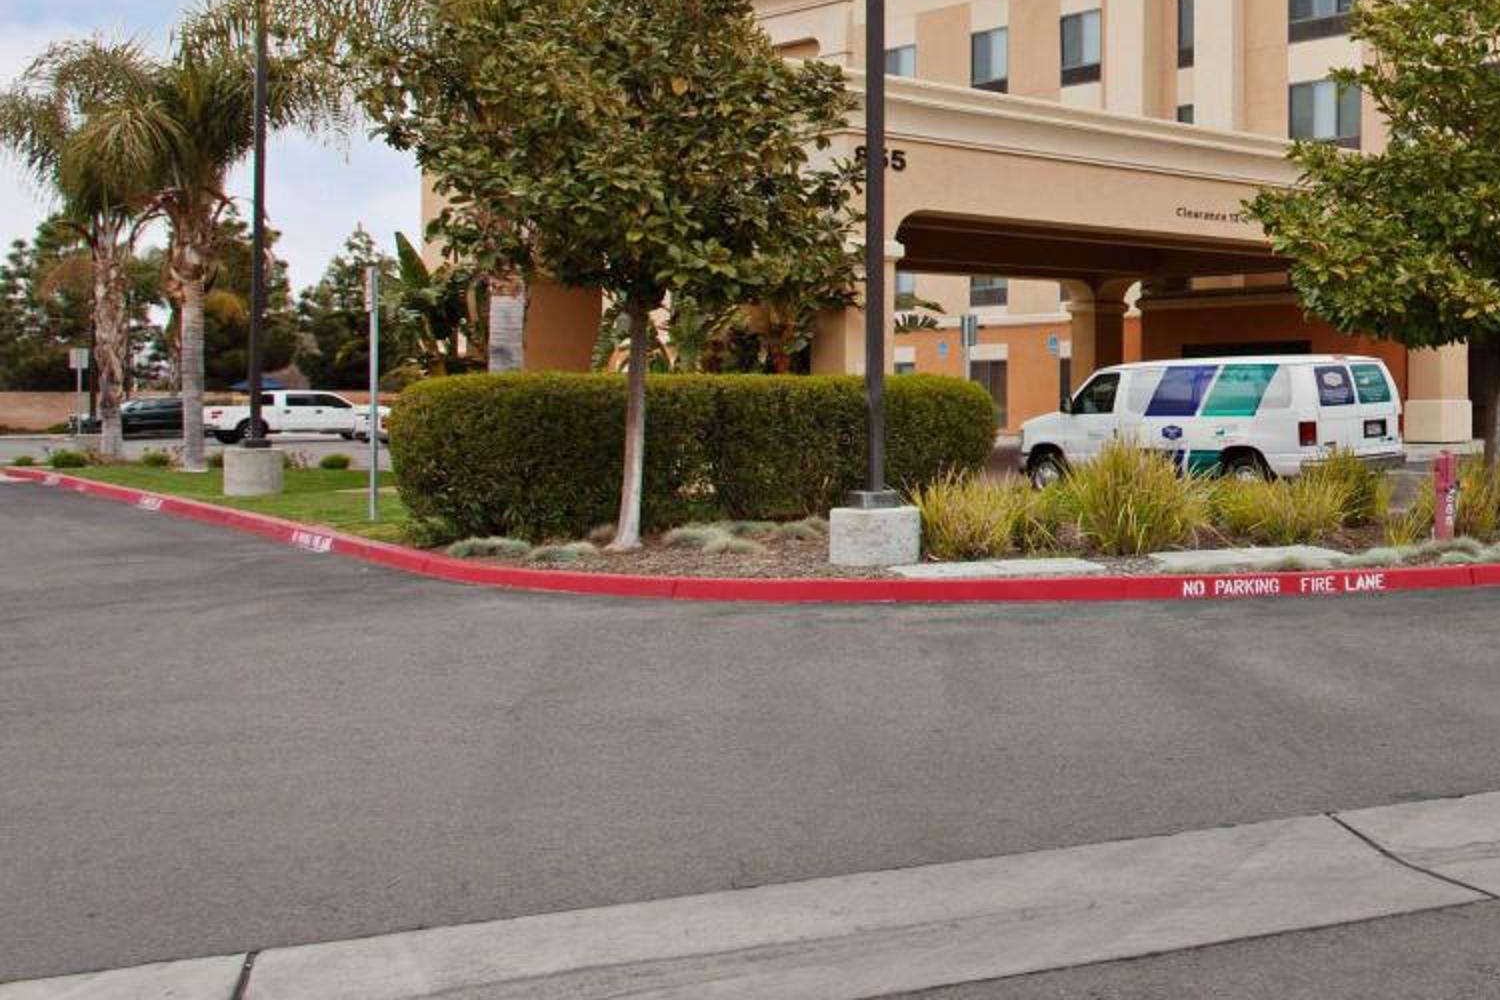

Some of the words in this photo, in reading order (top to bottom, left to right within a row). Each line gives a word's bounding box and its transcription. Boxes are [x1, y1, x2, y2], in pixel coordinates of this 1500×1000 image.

[1176, 206, 1227, 221] Clearance
[1183, 580, 1206, 597] NO
[1215, 578, 1280, 595] PARKING
[1300, 576, 1335, 593] FIRE
[1344, 574, 1386, 591] LANE
